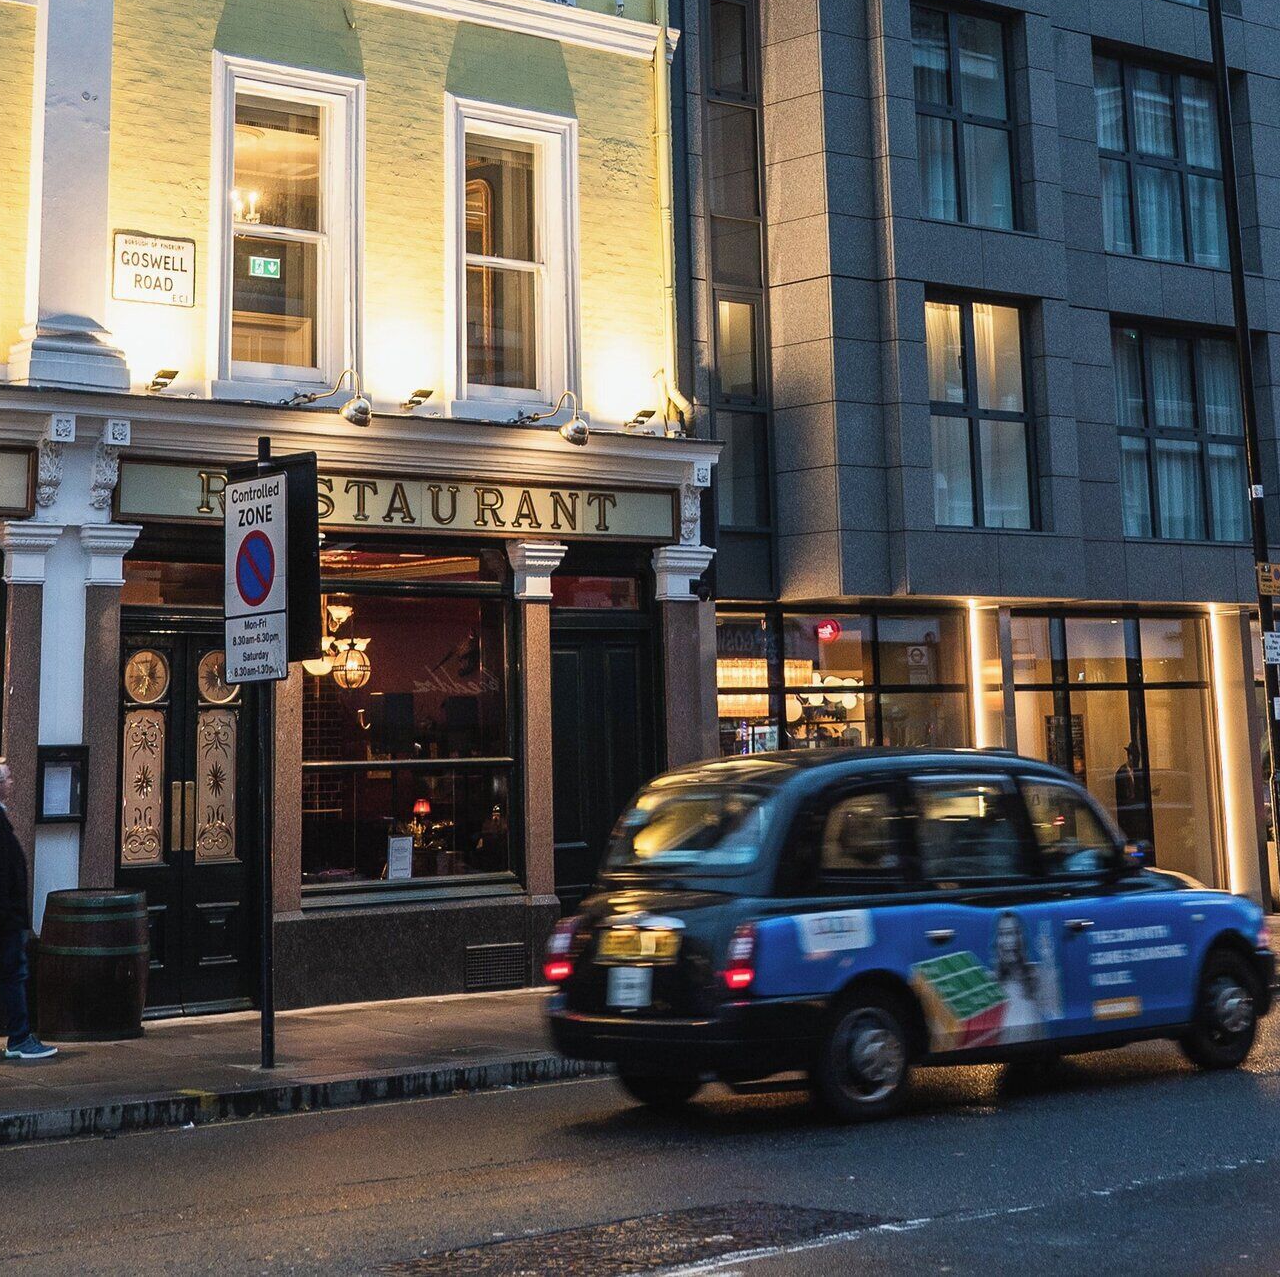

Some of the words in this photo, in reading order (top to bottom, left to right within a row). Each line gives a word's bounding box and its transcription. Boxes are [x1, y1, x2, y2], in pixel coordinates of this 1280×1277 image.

[121, 250, 188, 273] GOSWELL
[134, 273, 174, 292] ROAD
[197, 469, 618, 532] RSTAURANT
[231, 480, 280, 505] Controlled
[238, 504, 273, 527] ZONE
[243, 617, 268, 631] Mon-Fri
[242, 649, 269, 663] Saturday
